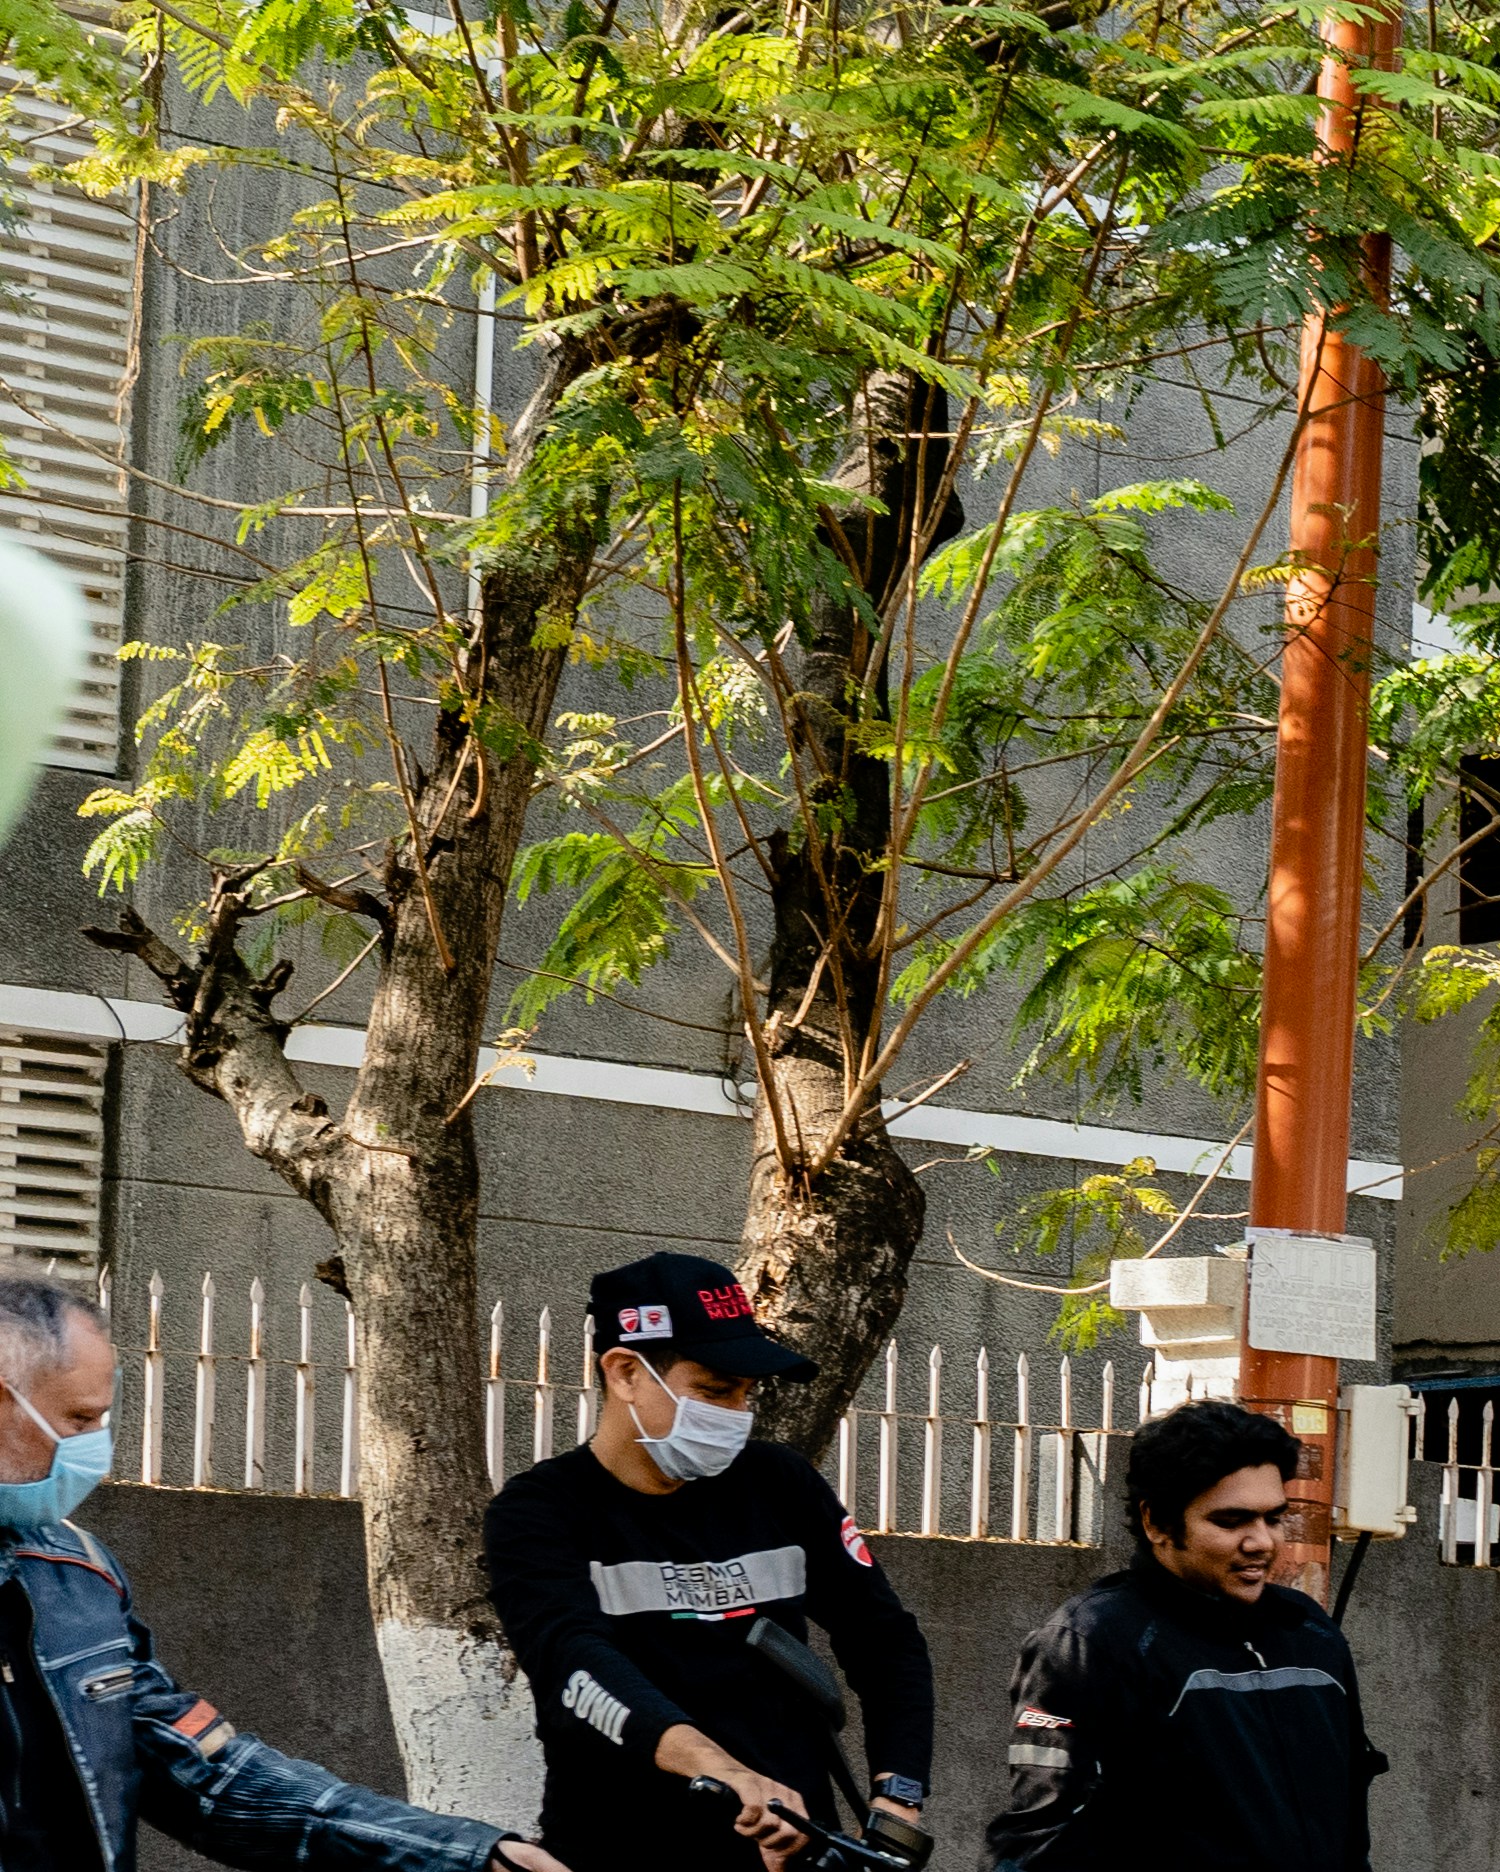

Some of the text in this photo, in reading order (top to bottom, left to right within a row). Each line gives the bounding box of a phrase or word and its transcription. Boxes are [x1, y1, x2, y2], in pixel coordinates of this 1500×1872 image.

[1254, 1239, 1373, 1289] SHIFTED
[659, 1561, 746, 1583] DESMO
[666, 1584, 755, 1607] MUMBAI
[561, 1669, 632, 1746] SUNIL
[1018, 1710, 1072, 1729] RST
